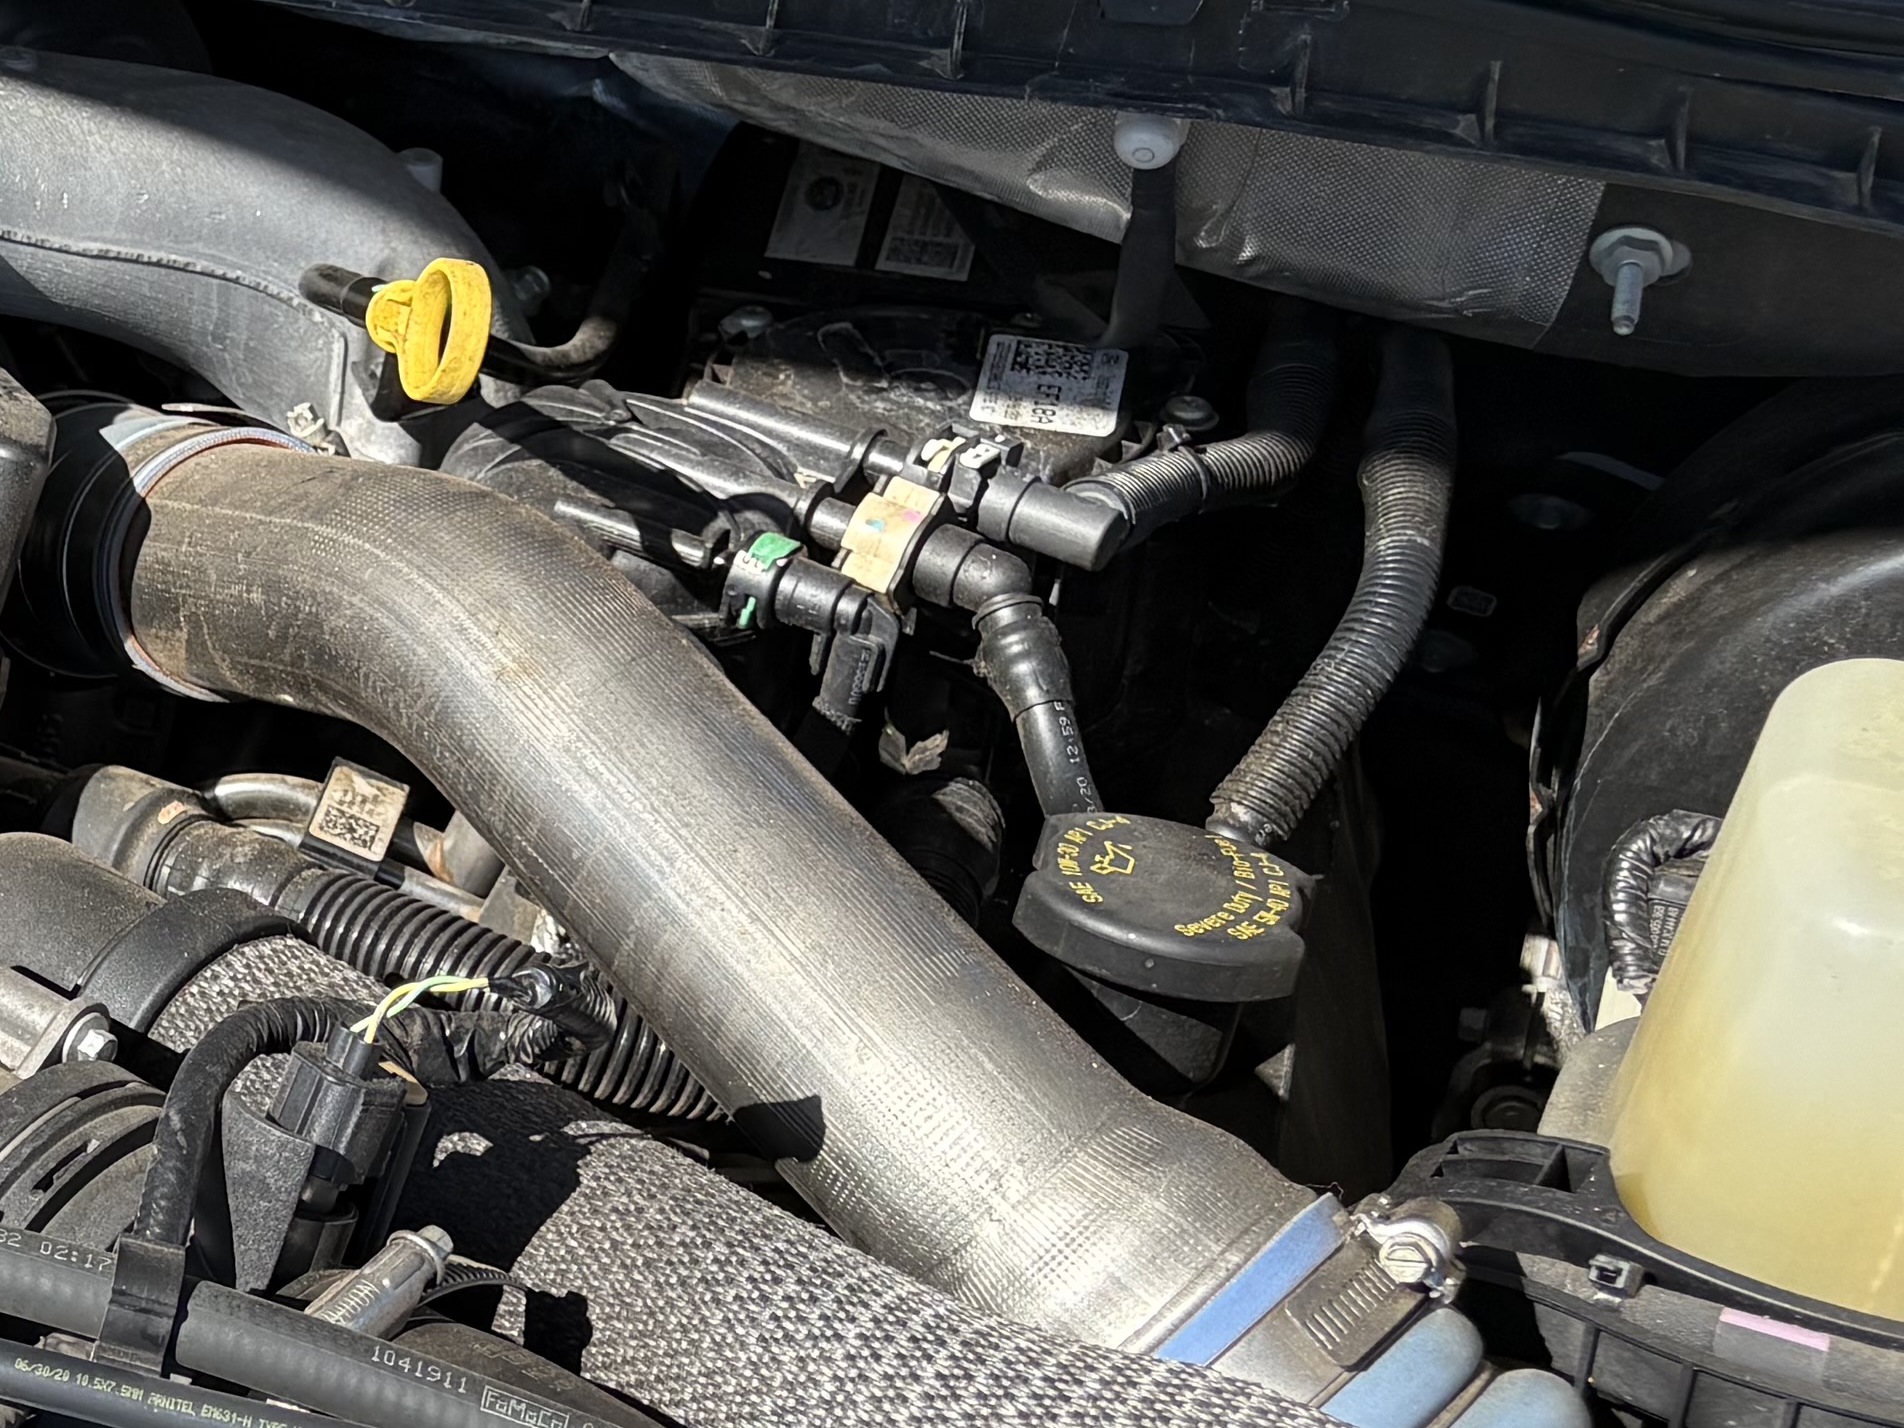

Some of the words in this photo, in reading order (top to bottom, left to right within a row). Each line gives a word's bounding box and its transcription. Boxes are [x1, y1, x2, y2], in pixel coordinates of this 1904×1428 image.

[1174, 911, 1235, 937] Severe
[13, 1357, 71, 1382] 06/30/20
[368, 1344, 472, 1394] 1041911
